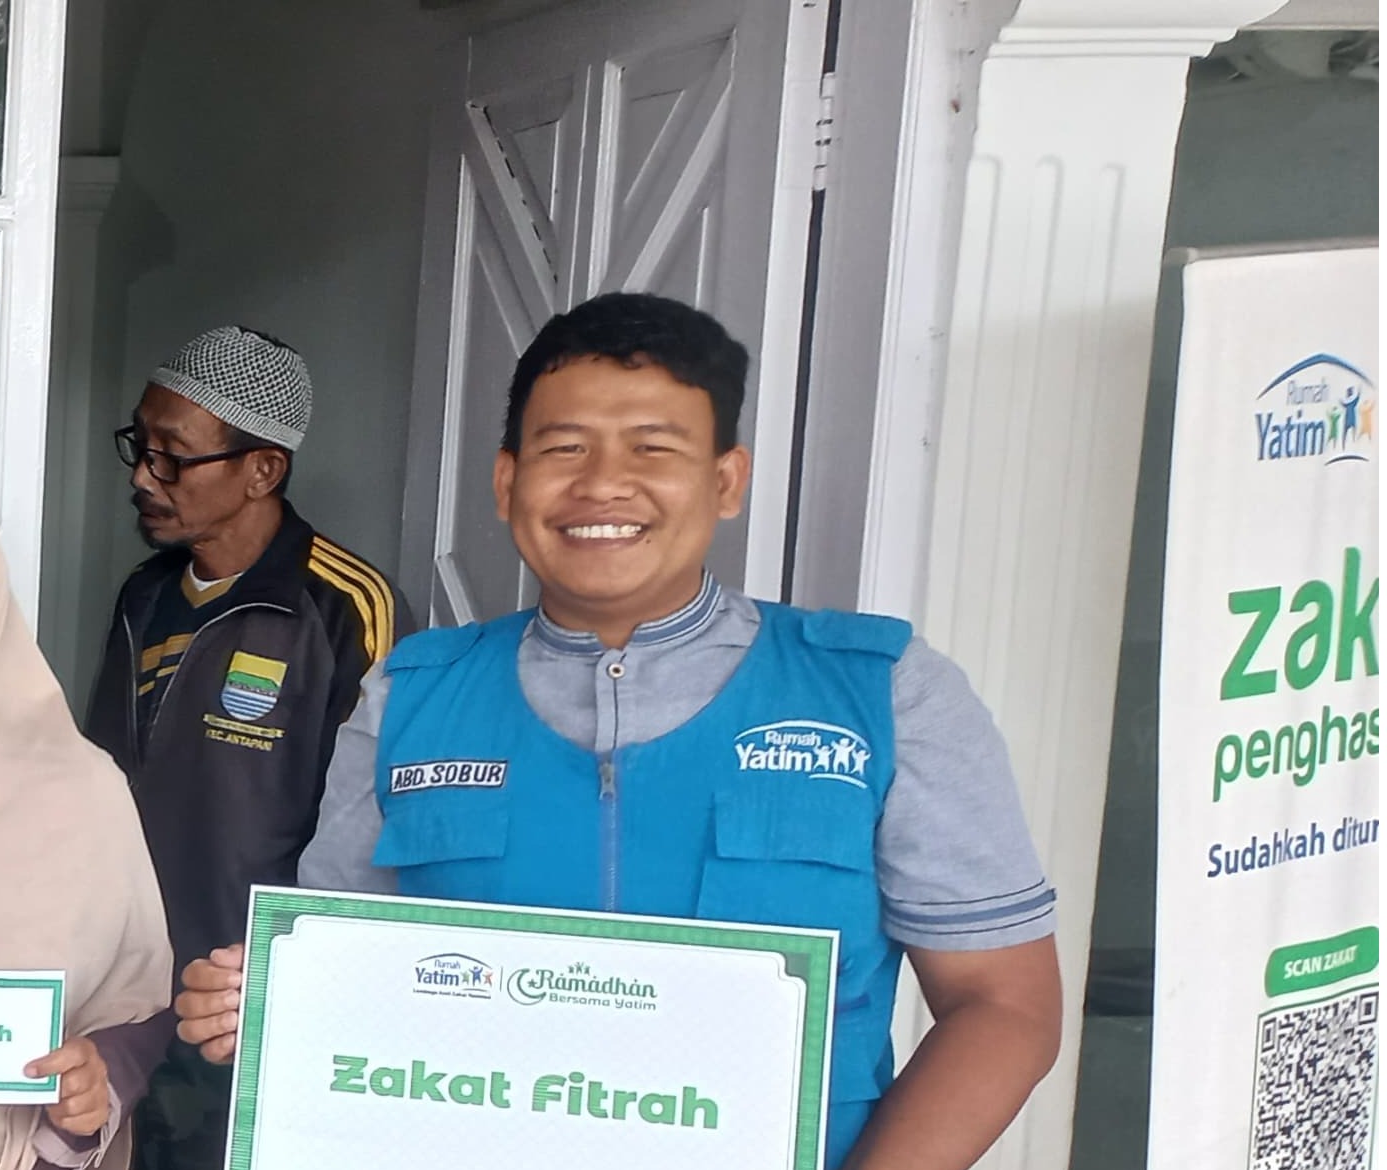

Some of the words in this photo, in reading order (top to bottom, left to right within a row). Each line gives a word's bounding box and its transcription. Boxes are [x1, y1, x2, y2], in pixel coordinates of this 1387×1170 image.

[1255, 409, 1325, 461] Yatim
[764, 730, 821, 746] Rumah
[735, 742, 813, 772] Yatim
[393, 767, 426, 790] ABD.
[430, 764, 502, 783] SOBUR
[1207, 822, 1325, 878] Sudahkah
[415, 967, 459, 987] Yatim
[1283, 956, 1322, 979] SCAN
[534, 968, 658, 998] Ramadhan
[549, 993, 611, 1008] Bersama
[614, 998, 657, 1011] Yatim
[329, 1054, 511, 1109] Zakat
[531, 1071, 719, 1129] Fitrah
